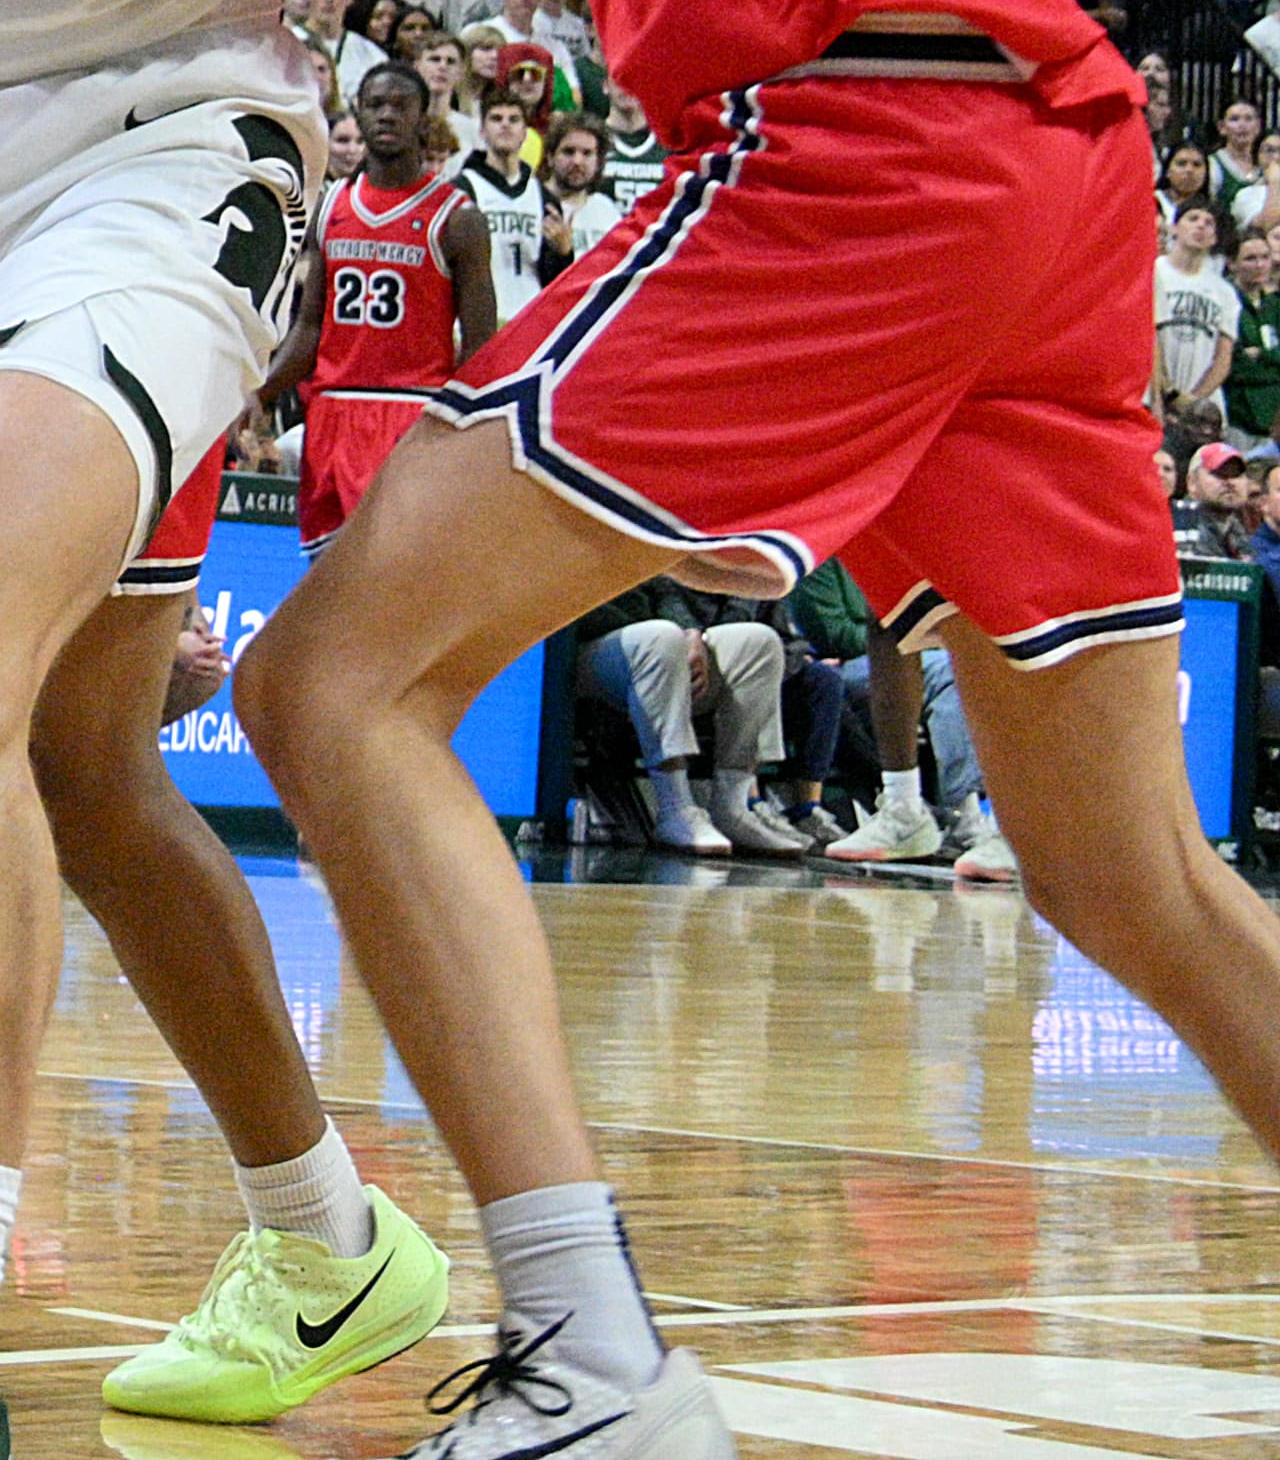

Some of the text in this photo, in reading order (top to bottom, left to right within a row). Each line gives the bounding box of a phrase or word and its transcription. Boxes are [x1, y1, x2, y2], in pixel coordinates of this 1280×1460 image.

[486, 211, 537, 238] STATE
[334, 267, 405, 329] 23
[244, 492, 297, 514] ACRIS
